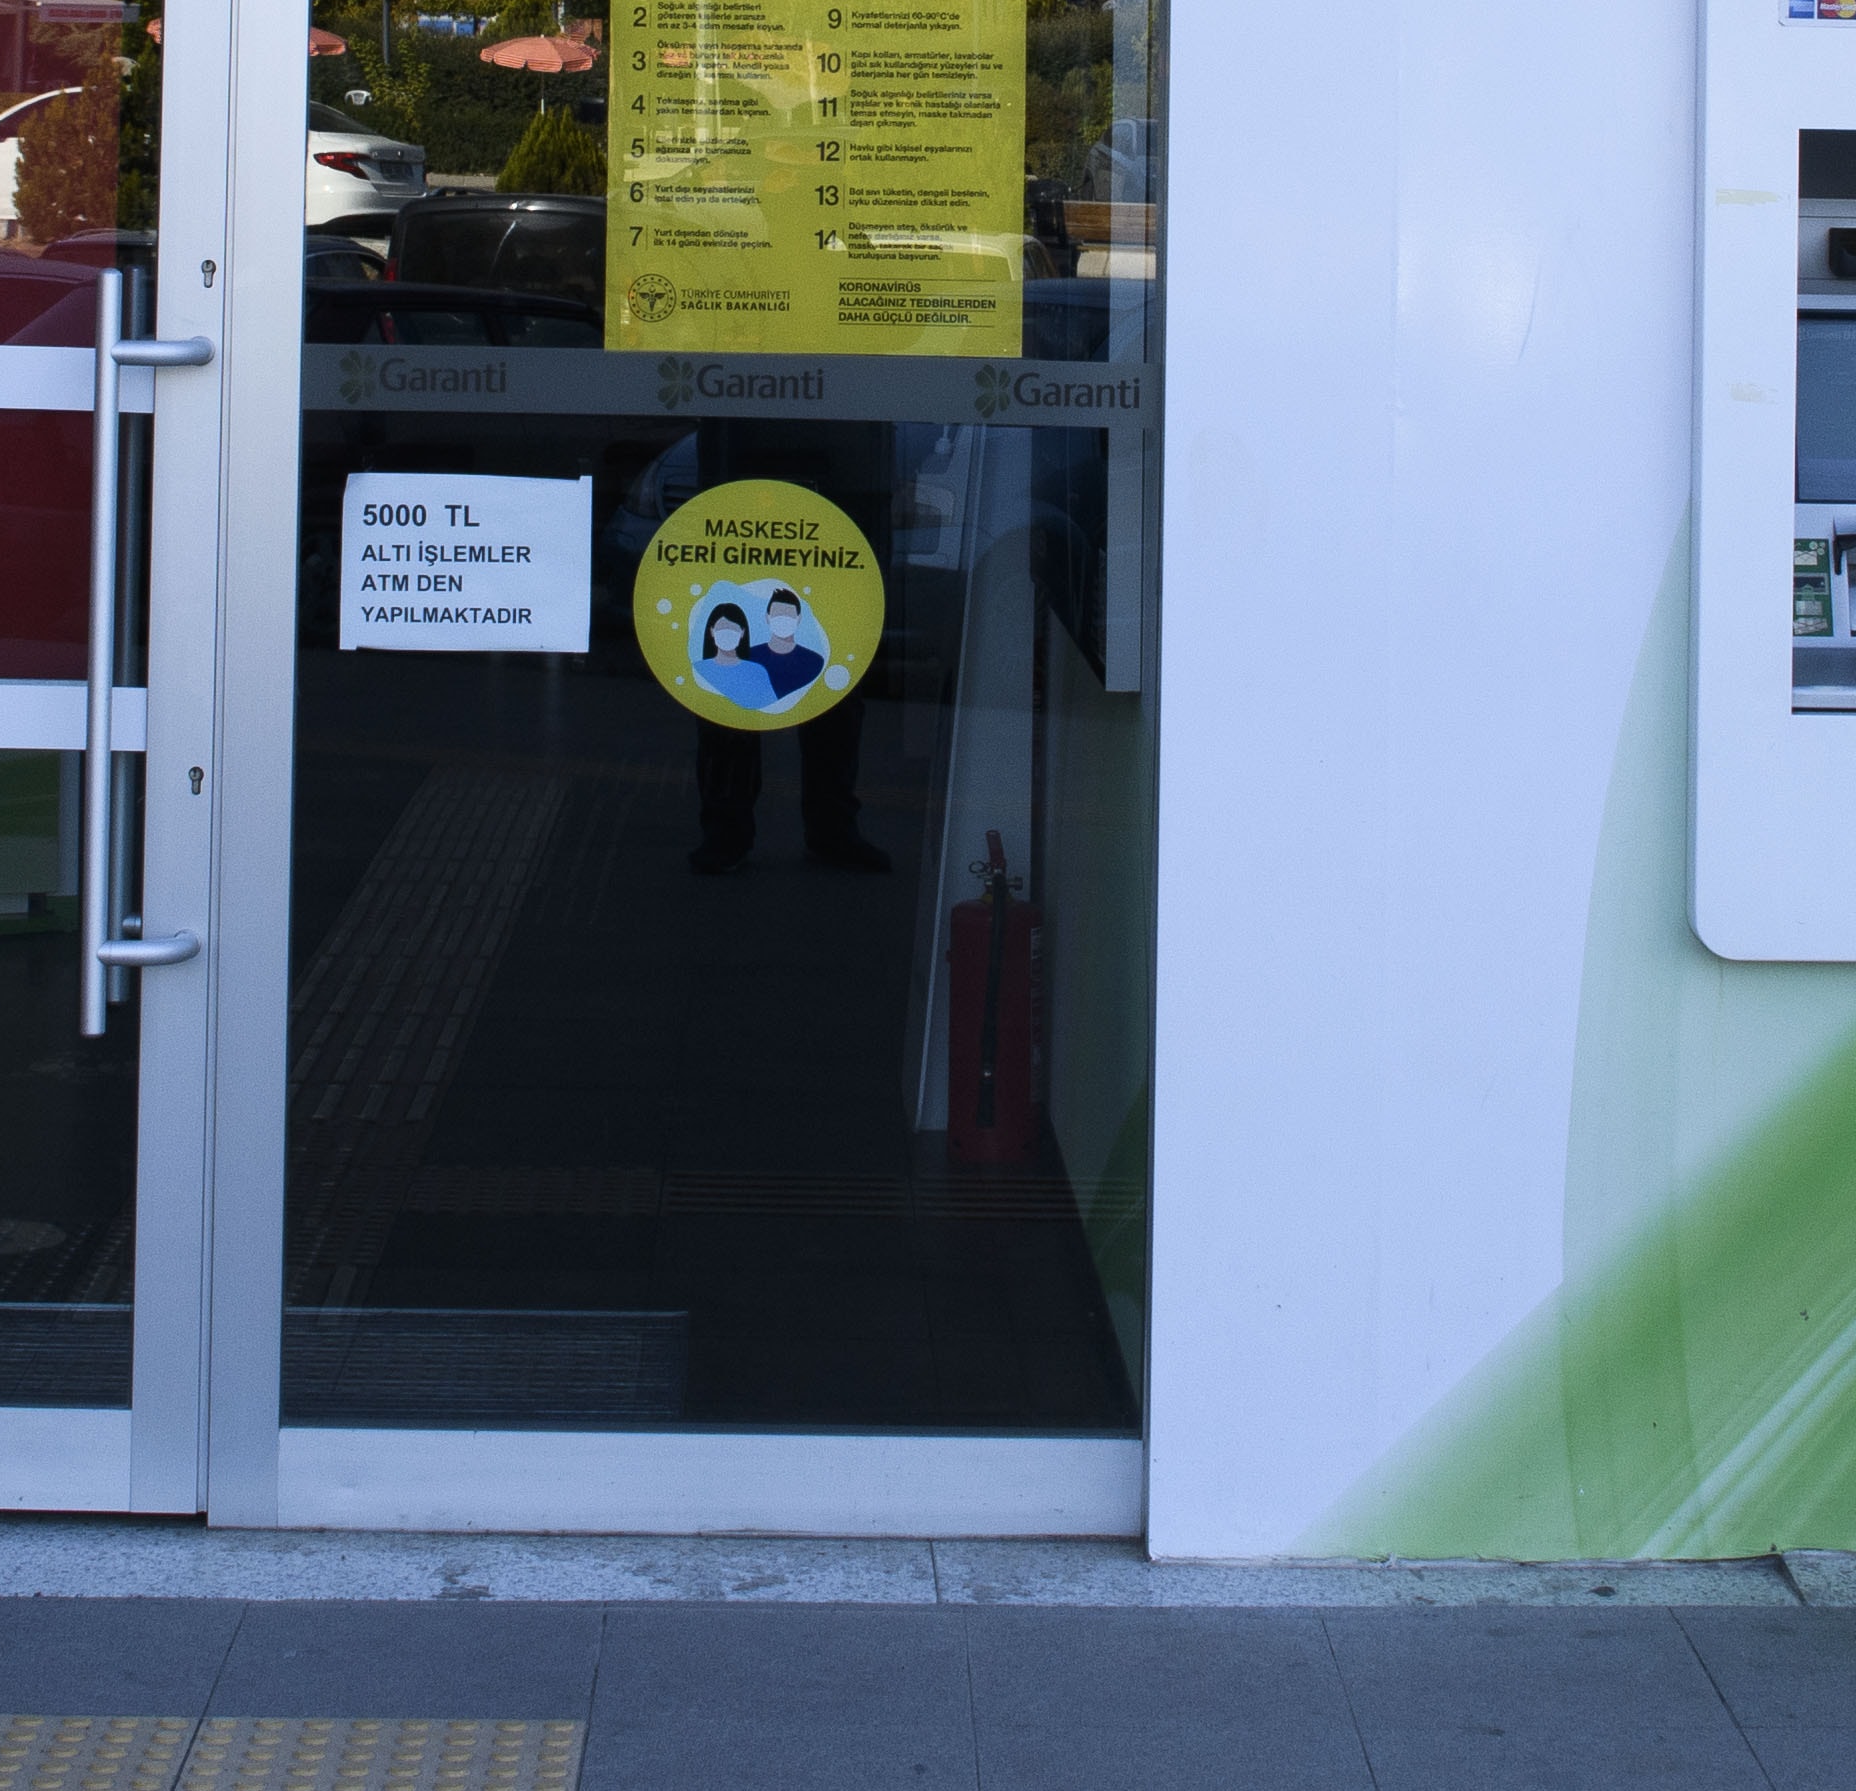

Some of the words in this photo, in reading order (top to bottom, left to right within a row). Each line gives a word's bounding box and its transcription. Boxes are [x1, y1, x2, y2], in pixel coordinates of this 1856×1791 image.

[632, 6, 647, 28] 2
[827, 8, 842, 30] 9
[631, 50, 646, 71] 3
[815, 52, 841, 74] 10
[631, 94, 646, 115] 4
[817, 96, 838, 118] 11
[631, 138, 645, 158] 5
[815, 140, 841, 162] 12
[849, 143, 875, 153] Havlu
[876, 144, 893, 154] gibi
[849, 153, 873, 162] ortak
[629, 181, 644, 203] 6
[814, 185, 840, 206] 13
[629, 226, 644, 247] 7
[653, 228, 672, 237] Yurt
[814, 229, 838, 250] 14
[680, 287, 722, 300] TÜRKİYE
[722, 288, 791, 301] CUMHURİYETİ
[838, 279, 922, 294] KORONAVİRÜS
[680, 299, 724, 312] SAĞLIK
[725, 299, 791, 312] BAKANLIĞI
[838, 294, 907, 309] ALACAĞINIZ
[909, 295, 997, 310] TEDBİRLERDEN
[838, 311, 871, 323] DAHA
[872, 309, 913, 325] GÜÇLÜ
[914, 310, 972, 325] DEĞİLDİR.
[378, 356, 508, 397] Garanti
[695, 362, 825, 402] Garanti
[1013, 370, 1142, 412] Garanti
[361, 502, 429, 529] 5000
[445, 504, 481, 529] TL
[703, 516, 821, 542] MASKESİZ
[360, 544, 413, 564] ALTI
[416, 540, 533, 569] İŞLEMLER
[656, 540, 717, 569] İÇERİ
[722, 542, 867, 572] GİRMEYİNİZ.
[360, 573, 412, 593] ATM
[417, 574, 464, 593] DEN
[360, 606, 534, 626] YAPILMAKTADIR
